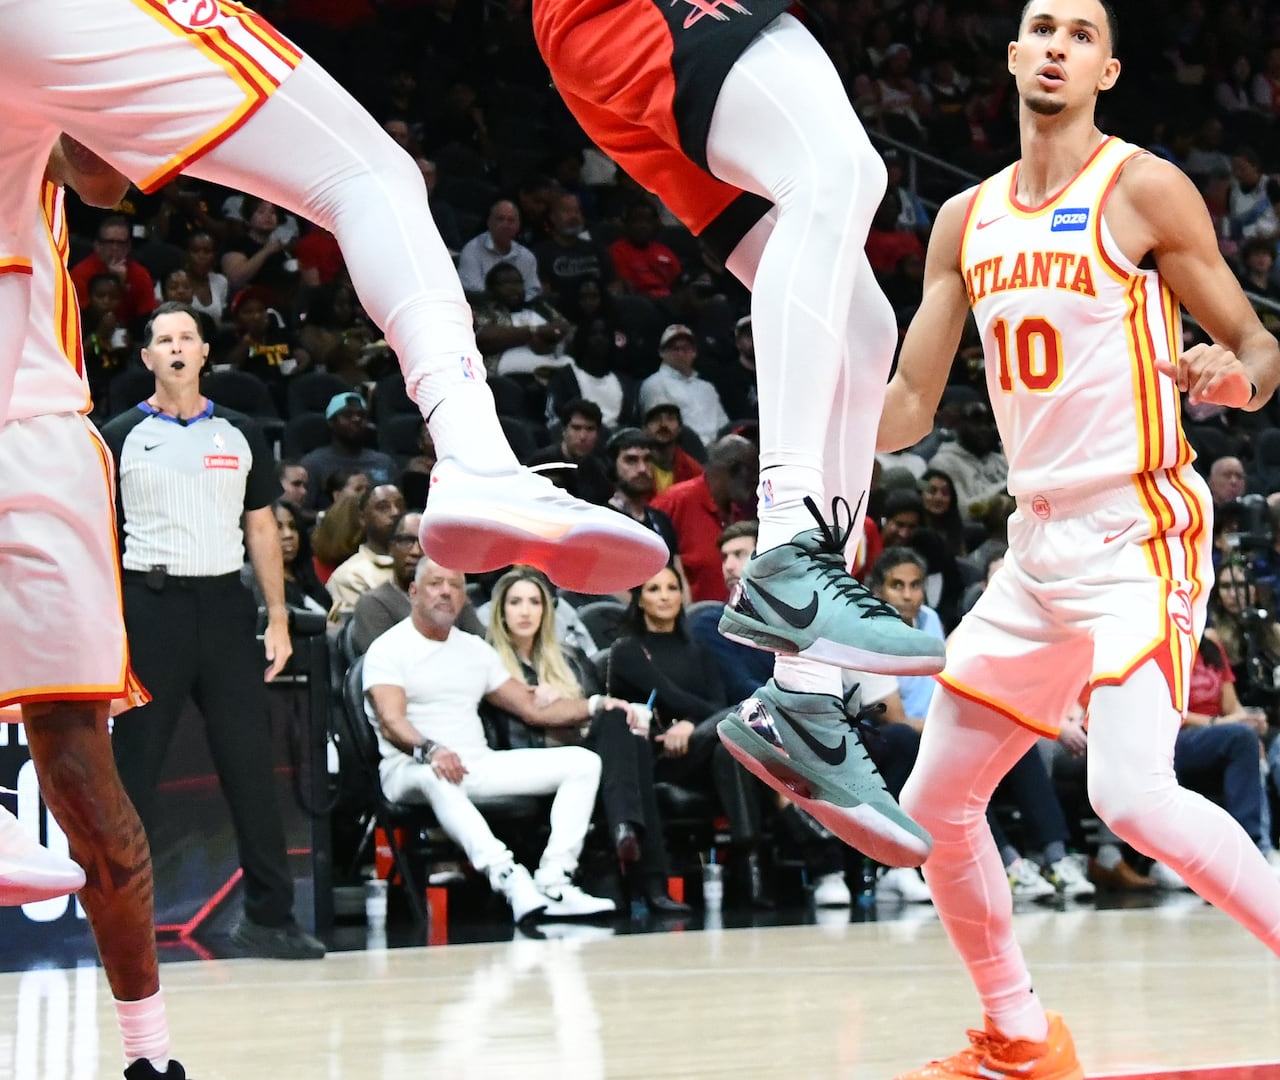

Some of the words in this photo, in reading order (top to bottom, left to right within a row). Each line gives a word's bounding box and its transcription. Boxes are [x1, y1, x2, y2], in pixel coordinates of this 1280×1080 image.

[1053, 213, 1088, 227] paze
[966, 252, 1098, 308] ATLANTA
[993, 315, 1064, 394] 10
